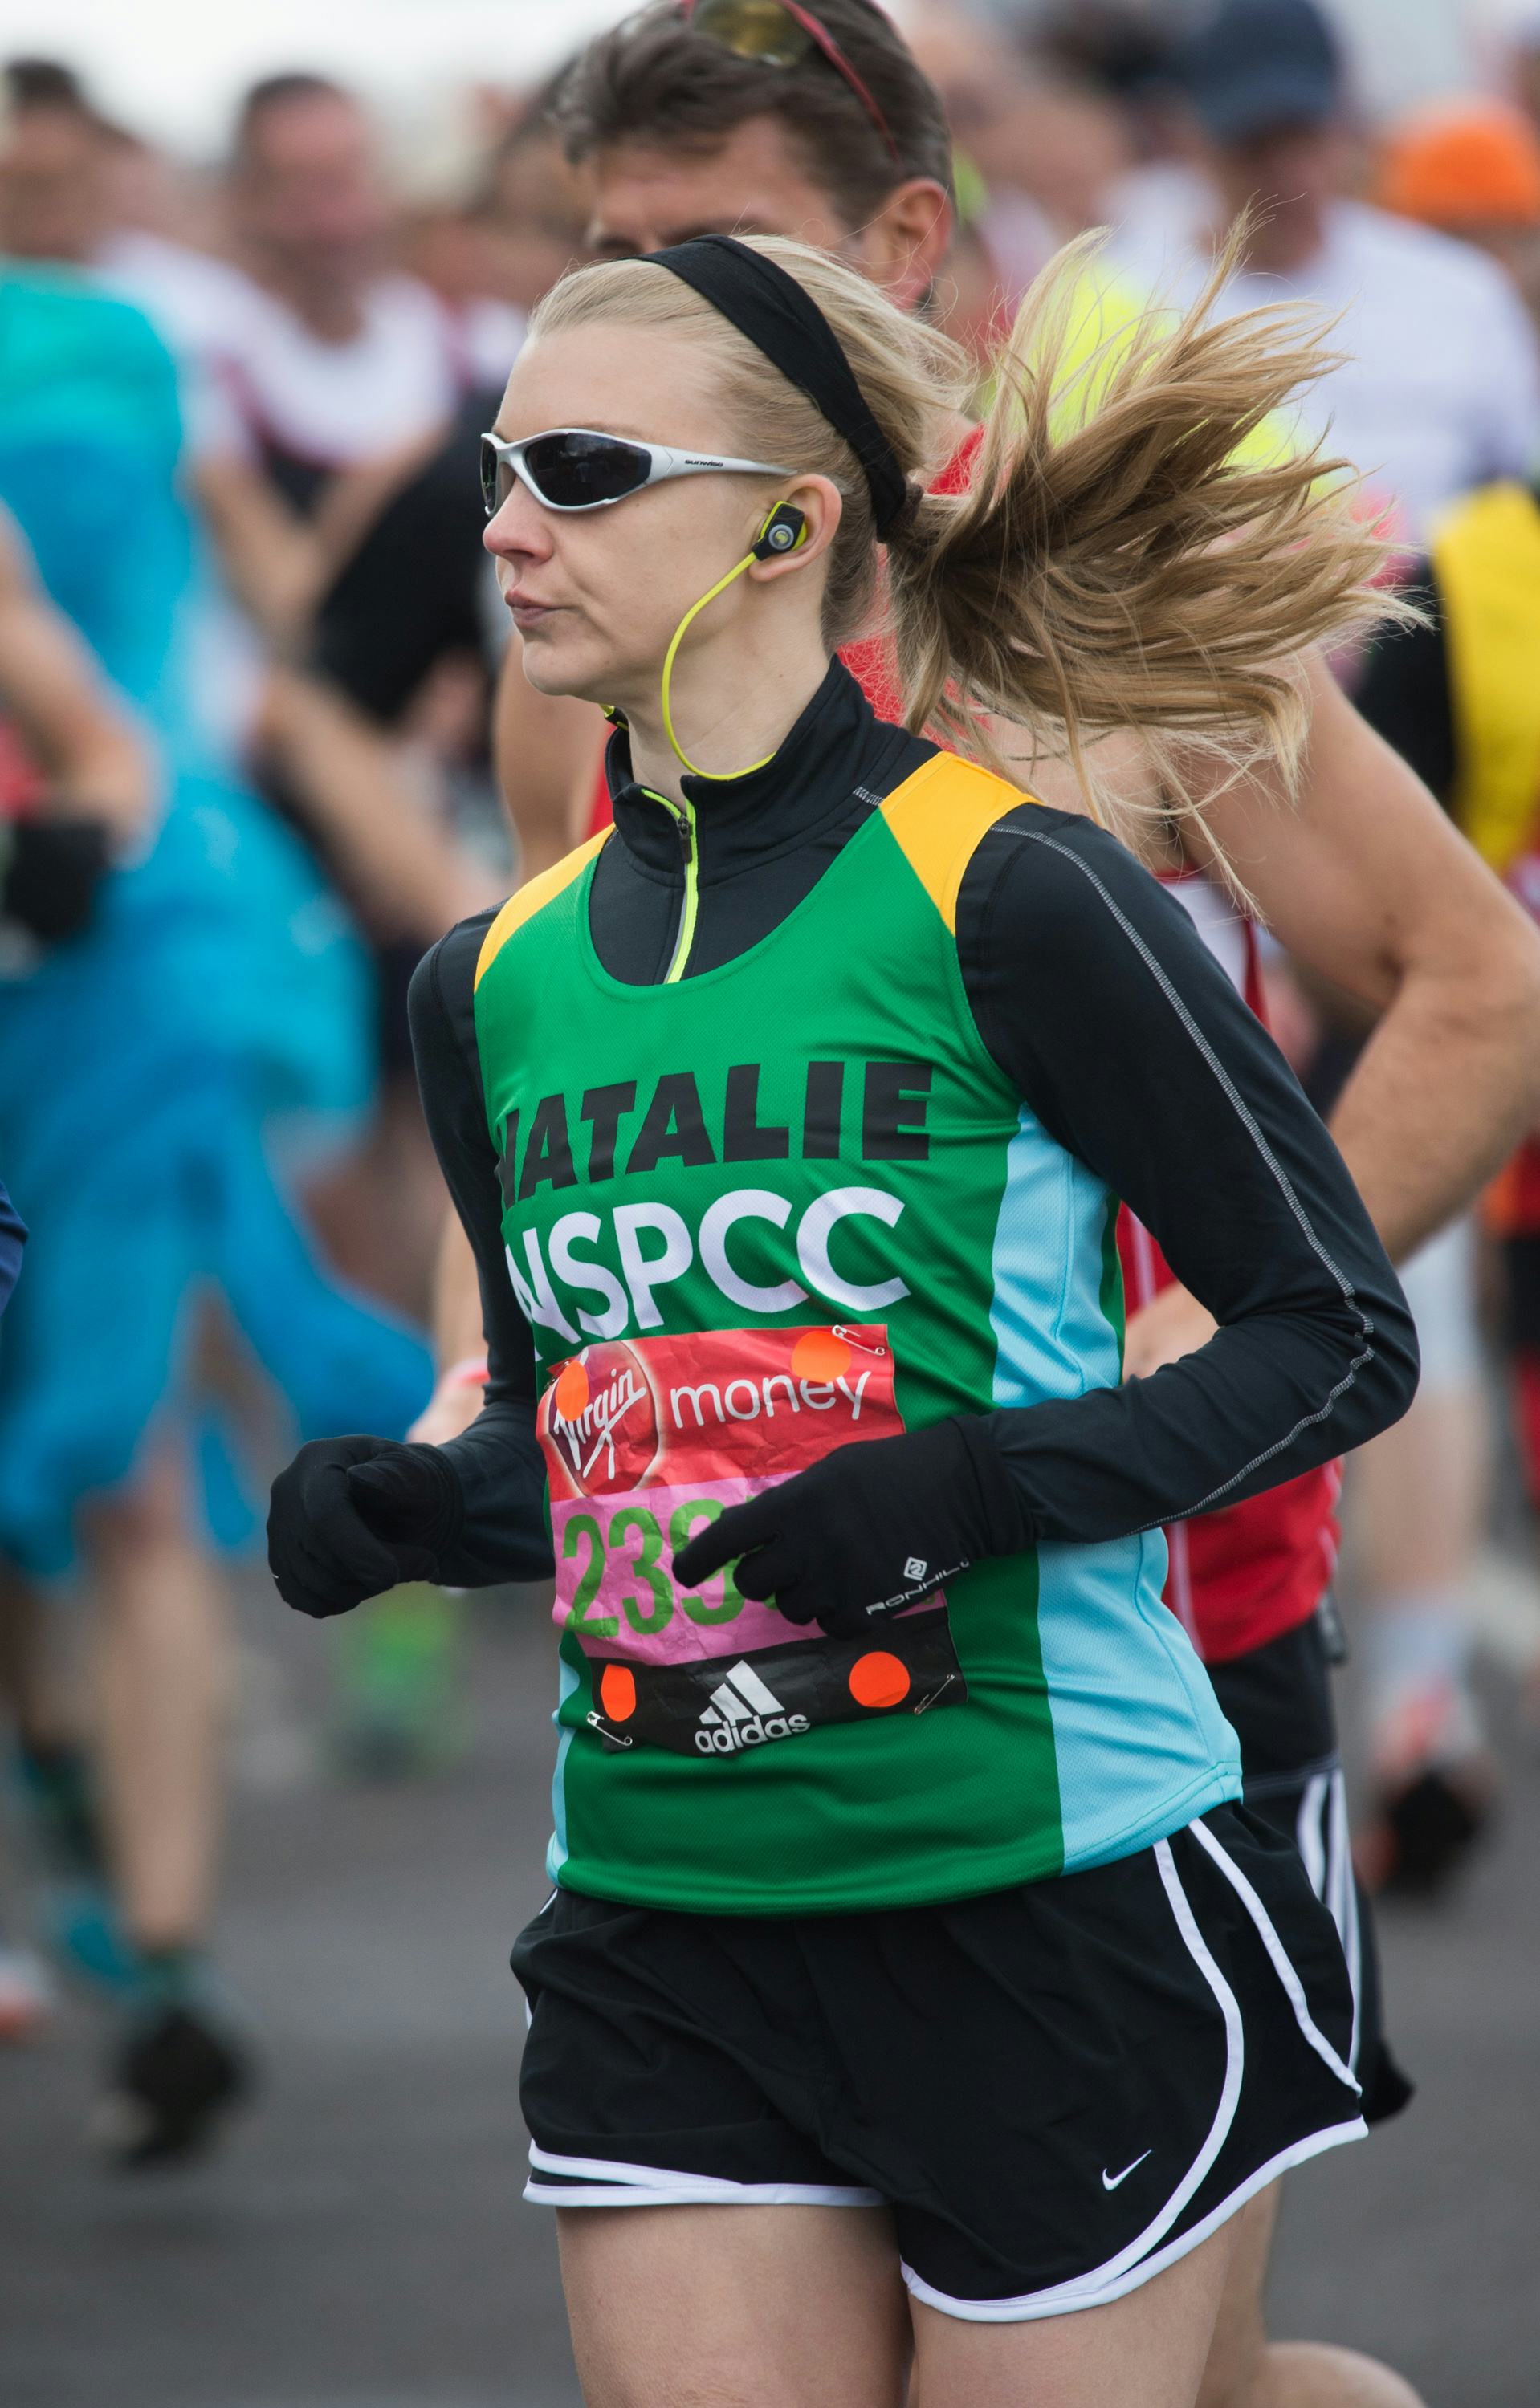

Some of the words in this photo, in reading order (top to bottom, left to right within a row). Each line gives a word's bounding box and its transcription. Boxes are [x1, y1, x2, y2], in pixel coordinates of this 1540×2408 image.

[505, 1186, 911, 1360] NSPCC
[670, 1370, 872, 1429] money
[695, 1714, 811, 1753] adidas
